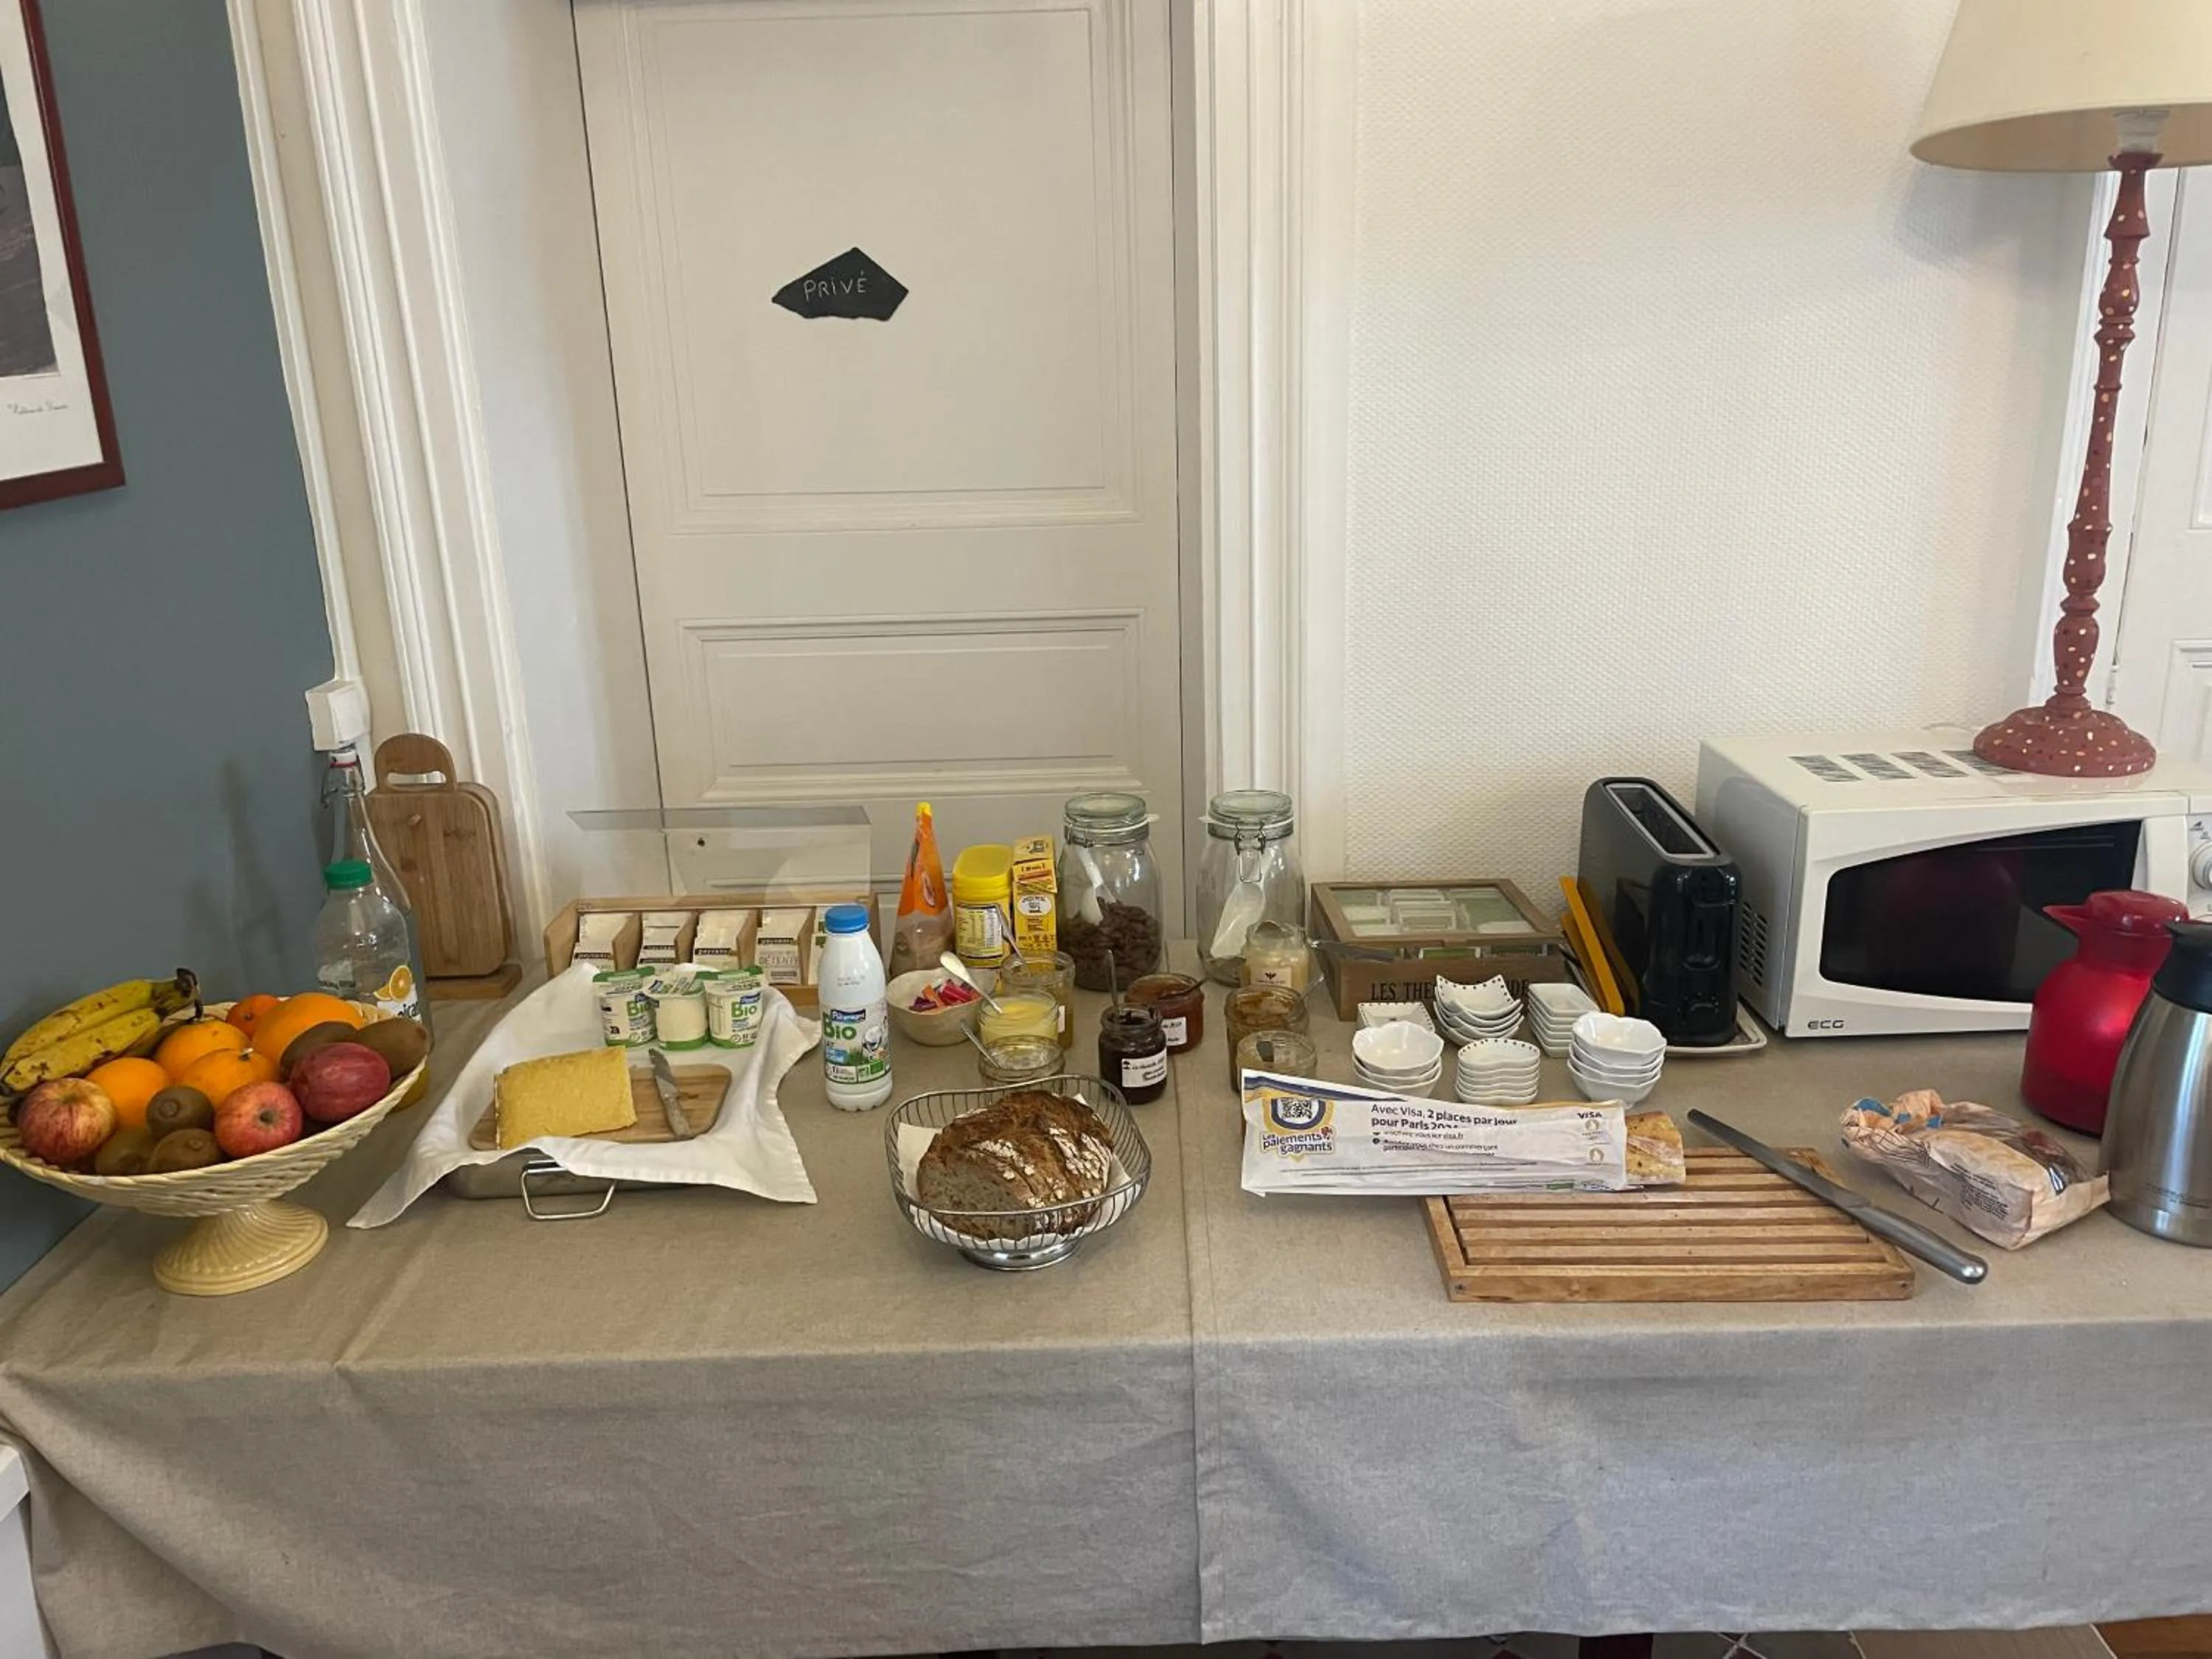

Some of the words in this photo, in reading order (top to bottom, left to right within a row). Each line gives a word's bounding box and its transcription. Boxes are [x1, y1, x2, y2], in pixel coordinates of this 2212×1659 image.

[803, 270, 867, 301] PRIVÉ
[1371, 982, 1397, 1001] LES
[1402, 981, 1436, 1000] THE
[1807, 1020, 1845, 1030] ECG
[1371, 1104, 1399, 1114] Avec
[1427, 1109, 1435, 1119] 2
[1437, 1110, 1472, 1124] places
[1474, 1116, 1493, 1126] par
[1576, 1111, 1603, 1119] VISA
[1371, 1117, 1399, 1127] pour
[1401, 1118, 1429, 1130] Paris
[1263, 1133, 1322, 1150] paiements
[1280, 1141, 1332, 1155] gagnants
